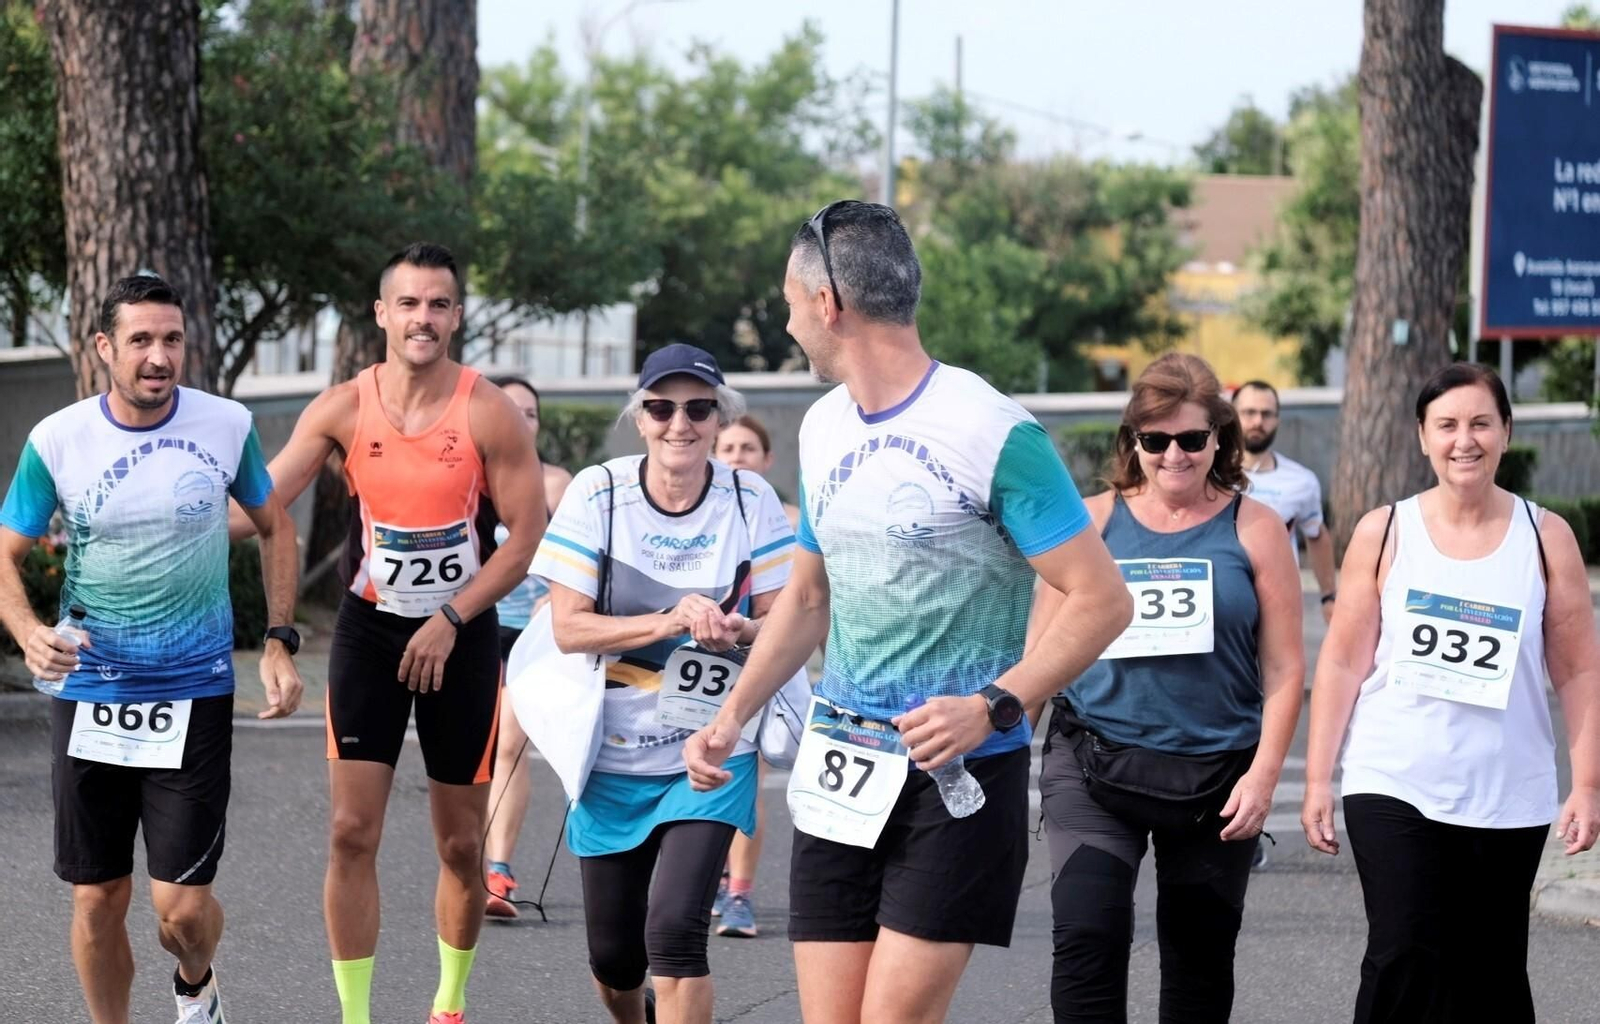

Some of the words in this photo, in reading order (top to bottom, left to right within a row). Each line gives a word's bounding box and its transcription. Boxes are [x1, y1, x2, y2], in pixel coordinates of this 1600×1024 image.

[1554, 157, 1574, 183] La
[641, 549, 654, 558] POR
[650, 534, 717, 550] CARRERA
[384, 553, 463, 586] 726
[653, 560, 666, 570] EN
[668, 560, 702, 572] SALUD
[1141, 588, 1196, 620] 33
[1412, 624, 1501, 671] 932
[678, 659, 736, 697] 93
[92, 701, 173, 734] 666
[818, 749, 876, 798] 87
